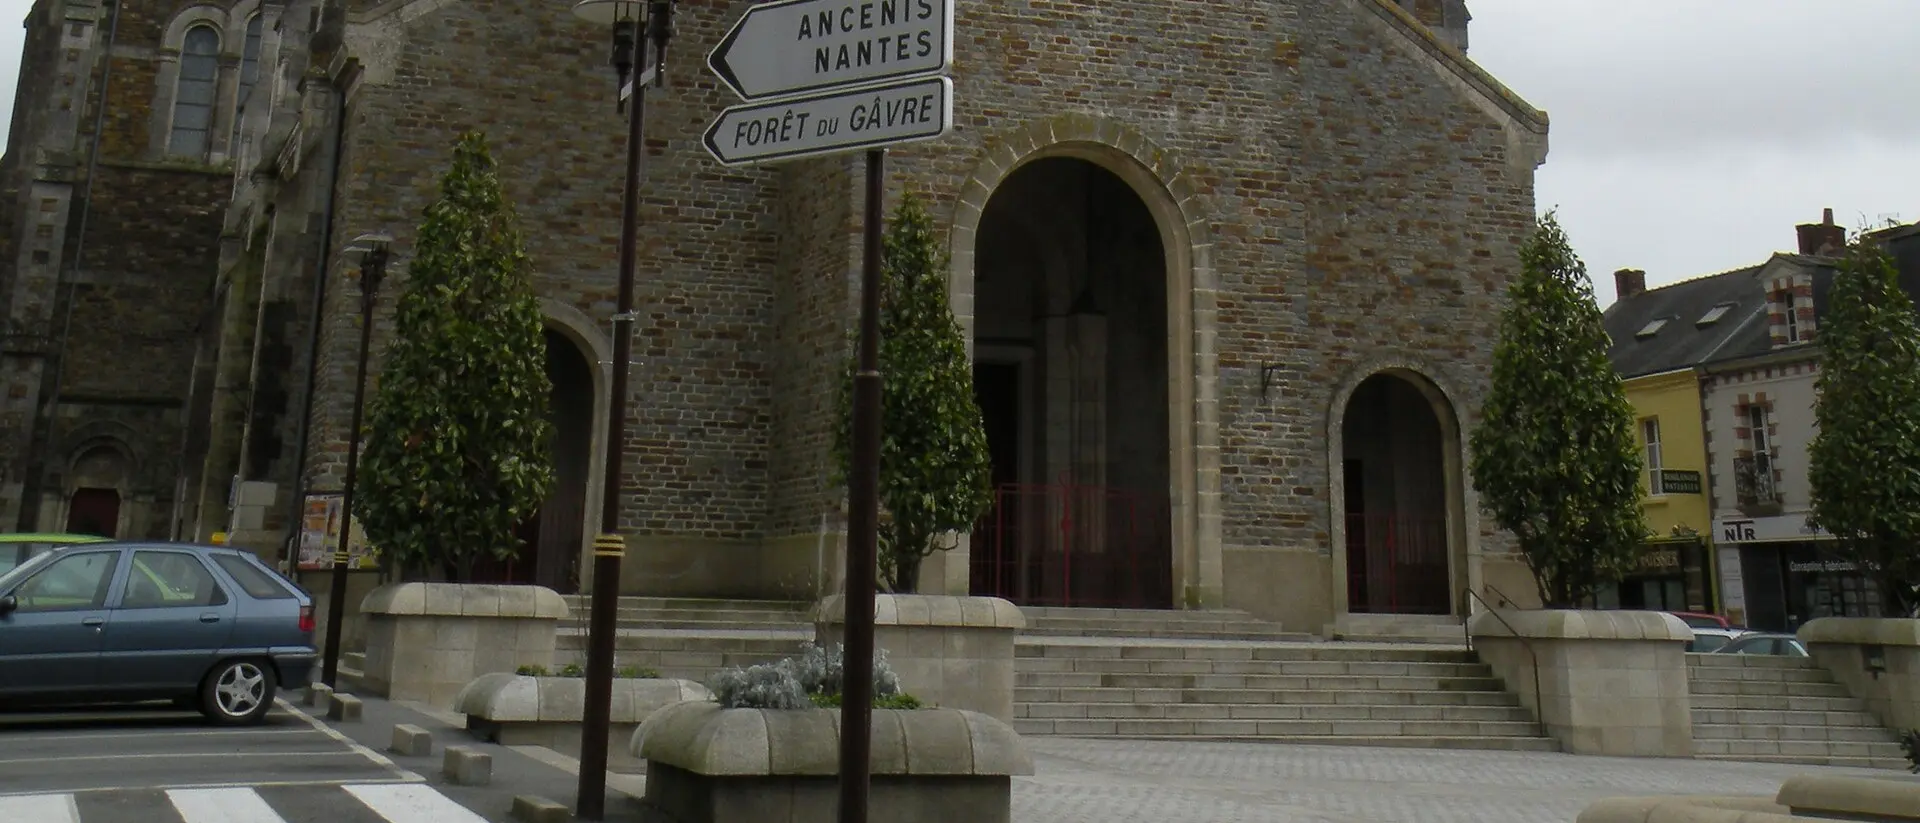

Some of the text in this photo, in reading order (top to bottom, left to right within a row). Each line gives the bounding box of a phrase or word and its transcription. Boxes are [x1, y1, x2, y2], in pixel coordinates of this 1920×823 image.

[798, 0, 932, 40] ANCENIS
[815, 30, 931, 73] NANTES
[734, 95, 934, 148] FORÊT DU GÂVRE
[1723, 520, 1756, 541] NTR
